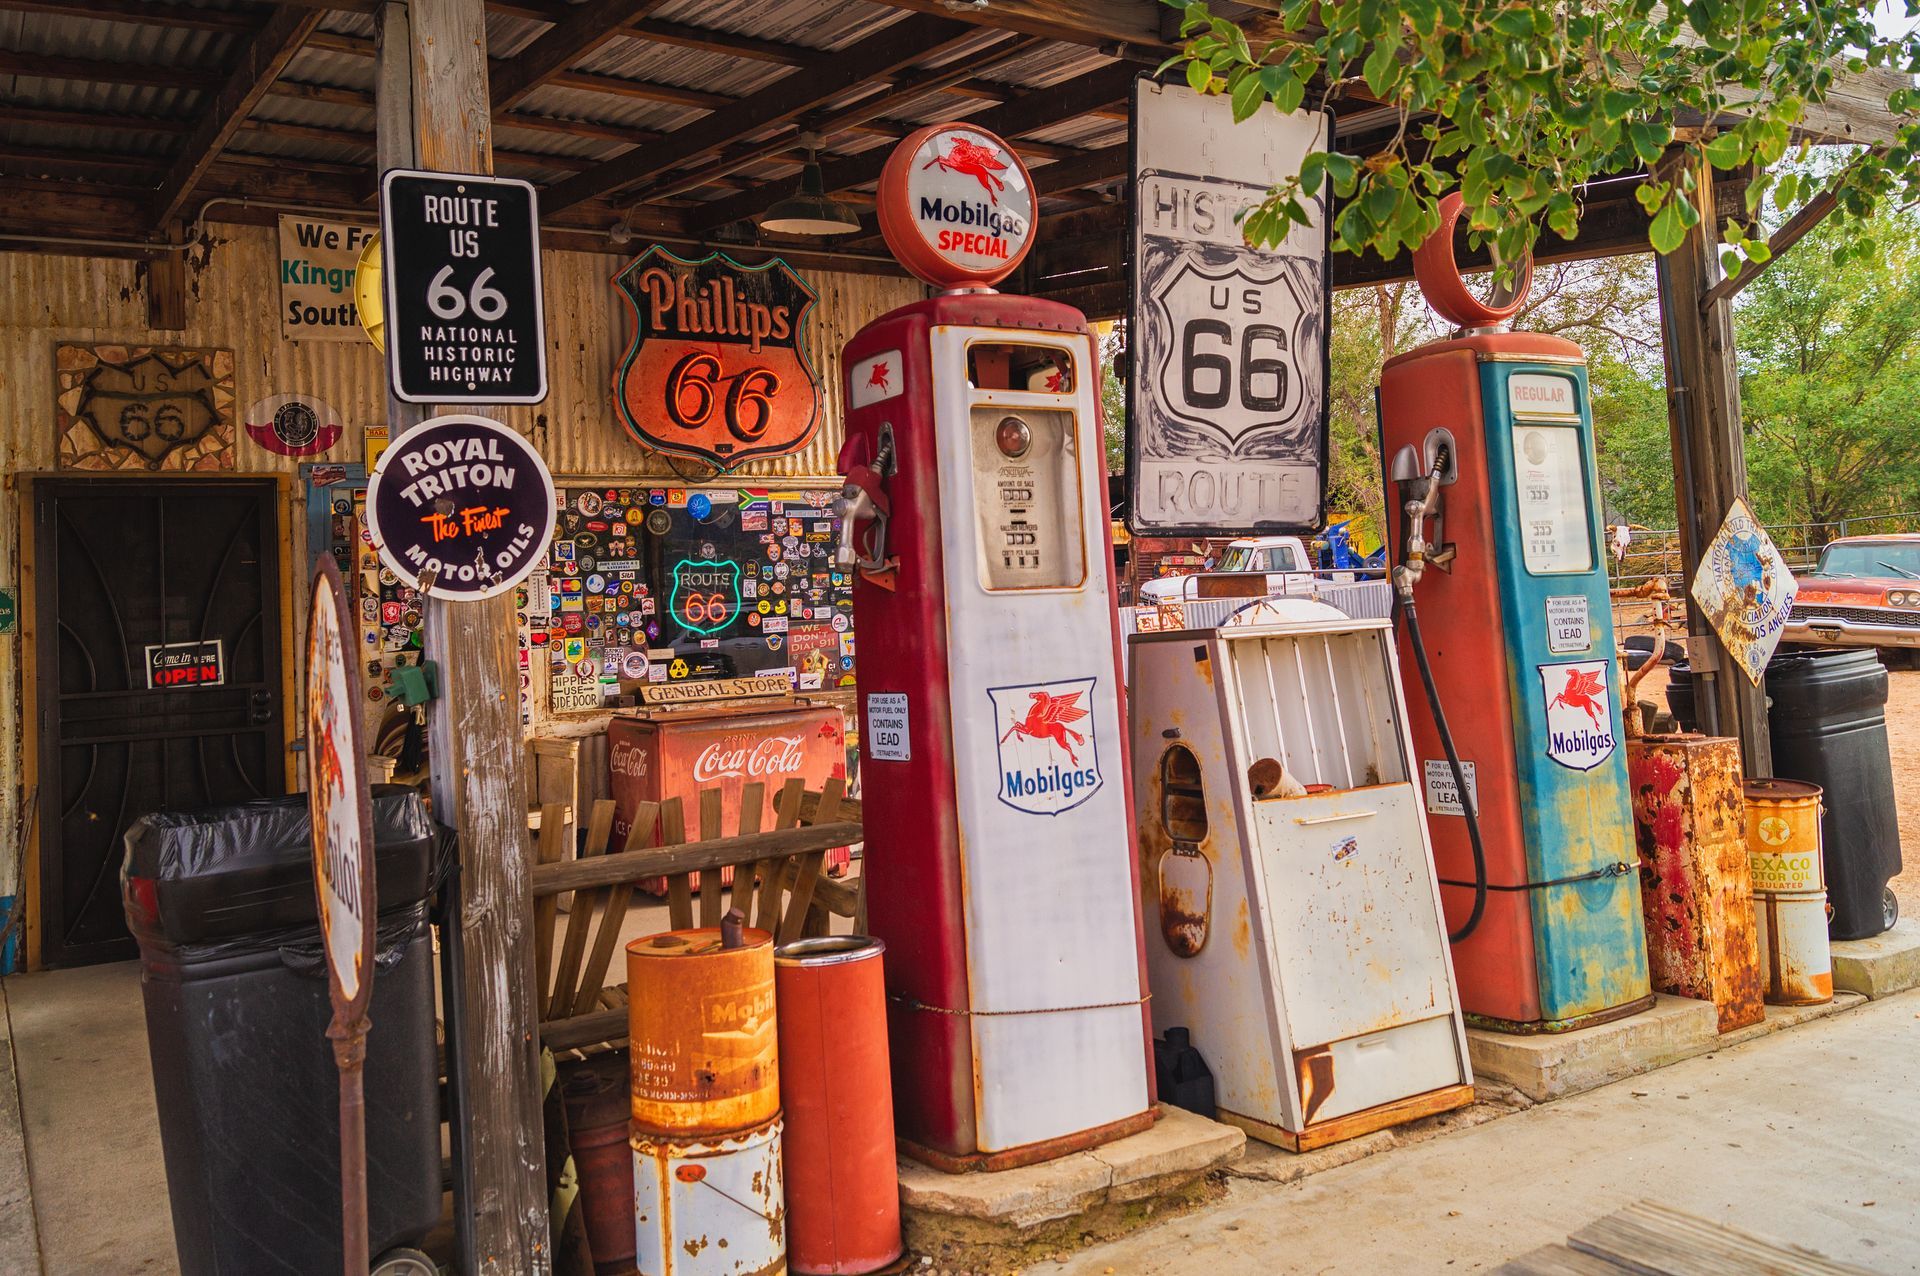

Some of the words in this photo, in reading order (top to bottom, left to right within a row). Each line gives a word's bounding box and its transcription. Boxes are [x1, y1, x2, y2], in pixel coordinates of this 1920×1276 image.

[424, 195, 499, 227] ROUTE
[921, 197, 1023, 237] Mobilgas
[296, 223, 339, 249] We
[450, 230, 479, 258] US
[938, 230, 1009, 259] SPECIAL
[427, 264, 508, 321] 66
[1210, 285, 1262, 314] US
[639, 267, 791, 354] Phillips
[421, 326, 517, 343] NATIONAL
[424, 347, 516, 363] HISTORIC
[1182, 318, 1288, 412] 66
[131, 372, 169, 392] US
[430, 367, 513, 382] HIGHWAY
[665, 351, 783, 442] 66
[1514, 386, 1564, 402] REGULAR
[119, 403, 186, 442] 66
[401, 438, 504, 477] ROYAL
[400, 464, 515, 508] TRITON
[1158, 468, 1300, 517] ROUTE
[420, 513, 460, 543] The
[459, 506, 511, 536] Finest
[404, 544, 491, 582] MOTOR
[496, 523, 535, 568] OILS
[680, 573, 730, 586] ROUTE
[685, 593, 727, 622] 66
[1768, 592, 1793, 635] ANGELES
[801, 624, 820, 633] WE
[1553, 617, 1585, 626] CONTAINS
[793, 630, 829, 643] DON'T
[1558, 628, 1582, 640] LEAD
[791, 643, 815, 652] DIAL
[819, 638, 836, 647] 911
[153, 650, 180, 665] Come
[180, 653, 191, 663] in
[155, 665, 217, 685] OPEN
[552, 674, 596, 687] HIPPIES
[563, 686, 584, 696] USE
[649, 680, 730, 702] GENERAL
[733, 678, 787, 695] STORE
[552, 695, 571, 709] SIDE
[573, 693, 598, 707] DOOR
[869, 706, 882, 714] MOTOR
[882, 706, 894, 714] FUEL
[894, 706, 906, 714] ONLY
[872, 719, 904, 730] CONTAINS
[723, 733, 757, 743] DRINK
[876, 732, 900, 746] LEAD
[1552, 730, 1611, 756] Mobilgas
[610, 743, 648, 777] Coca-Cola
[693, 734, 807, 783] Coca-Cola
[1006, 765, 1097, 798] Mobilgas
[1430, 780, 1472, 791] CONTAS
[1751, 857, 1811, 872] EXACO
[1751, 871, 1787, 881] OTOR
[1791, 871, 1811, 881] OIL
[1752, 881, 1804, 889] NSULATED
